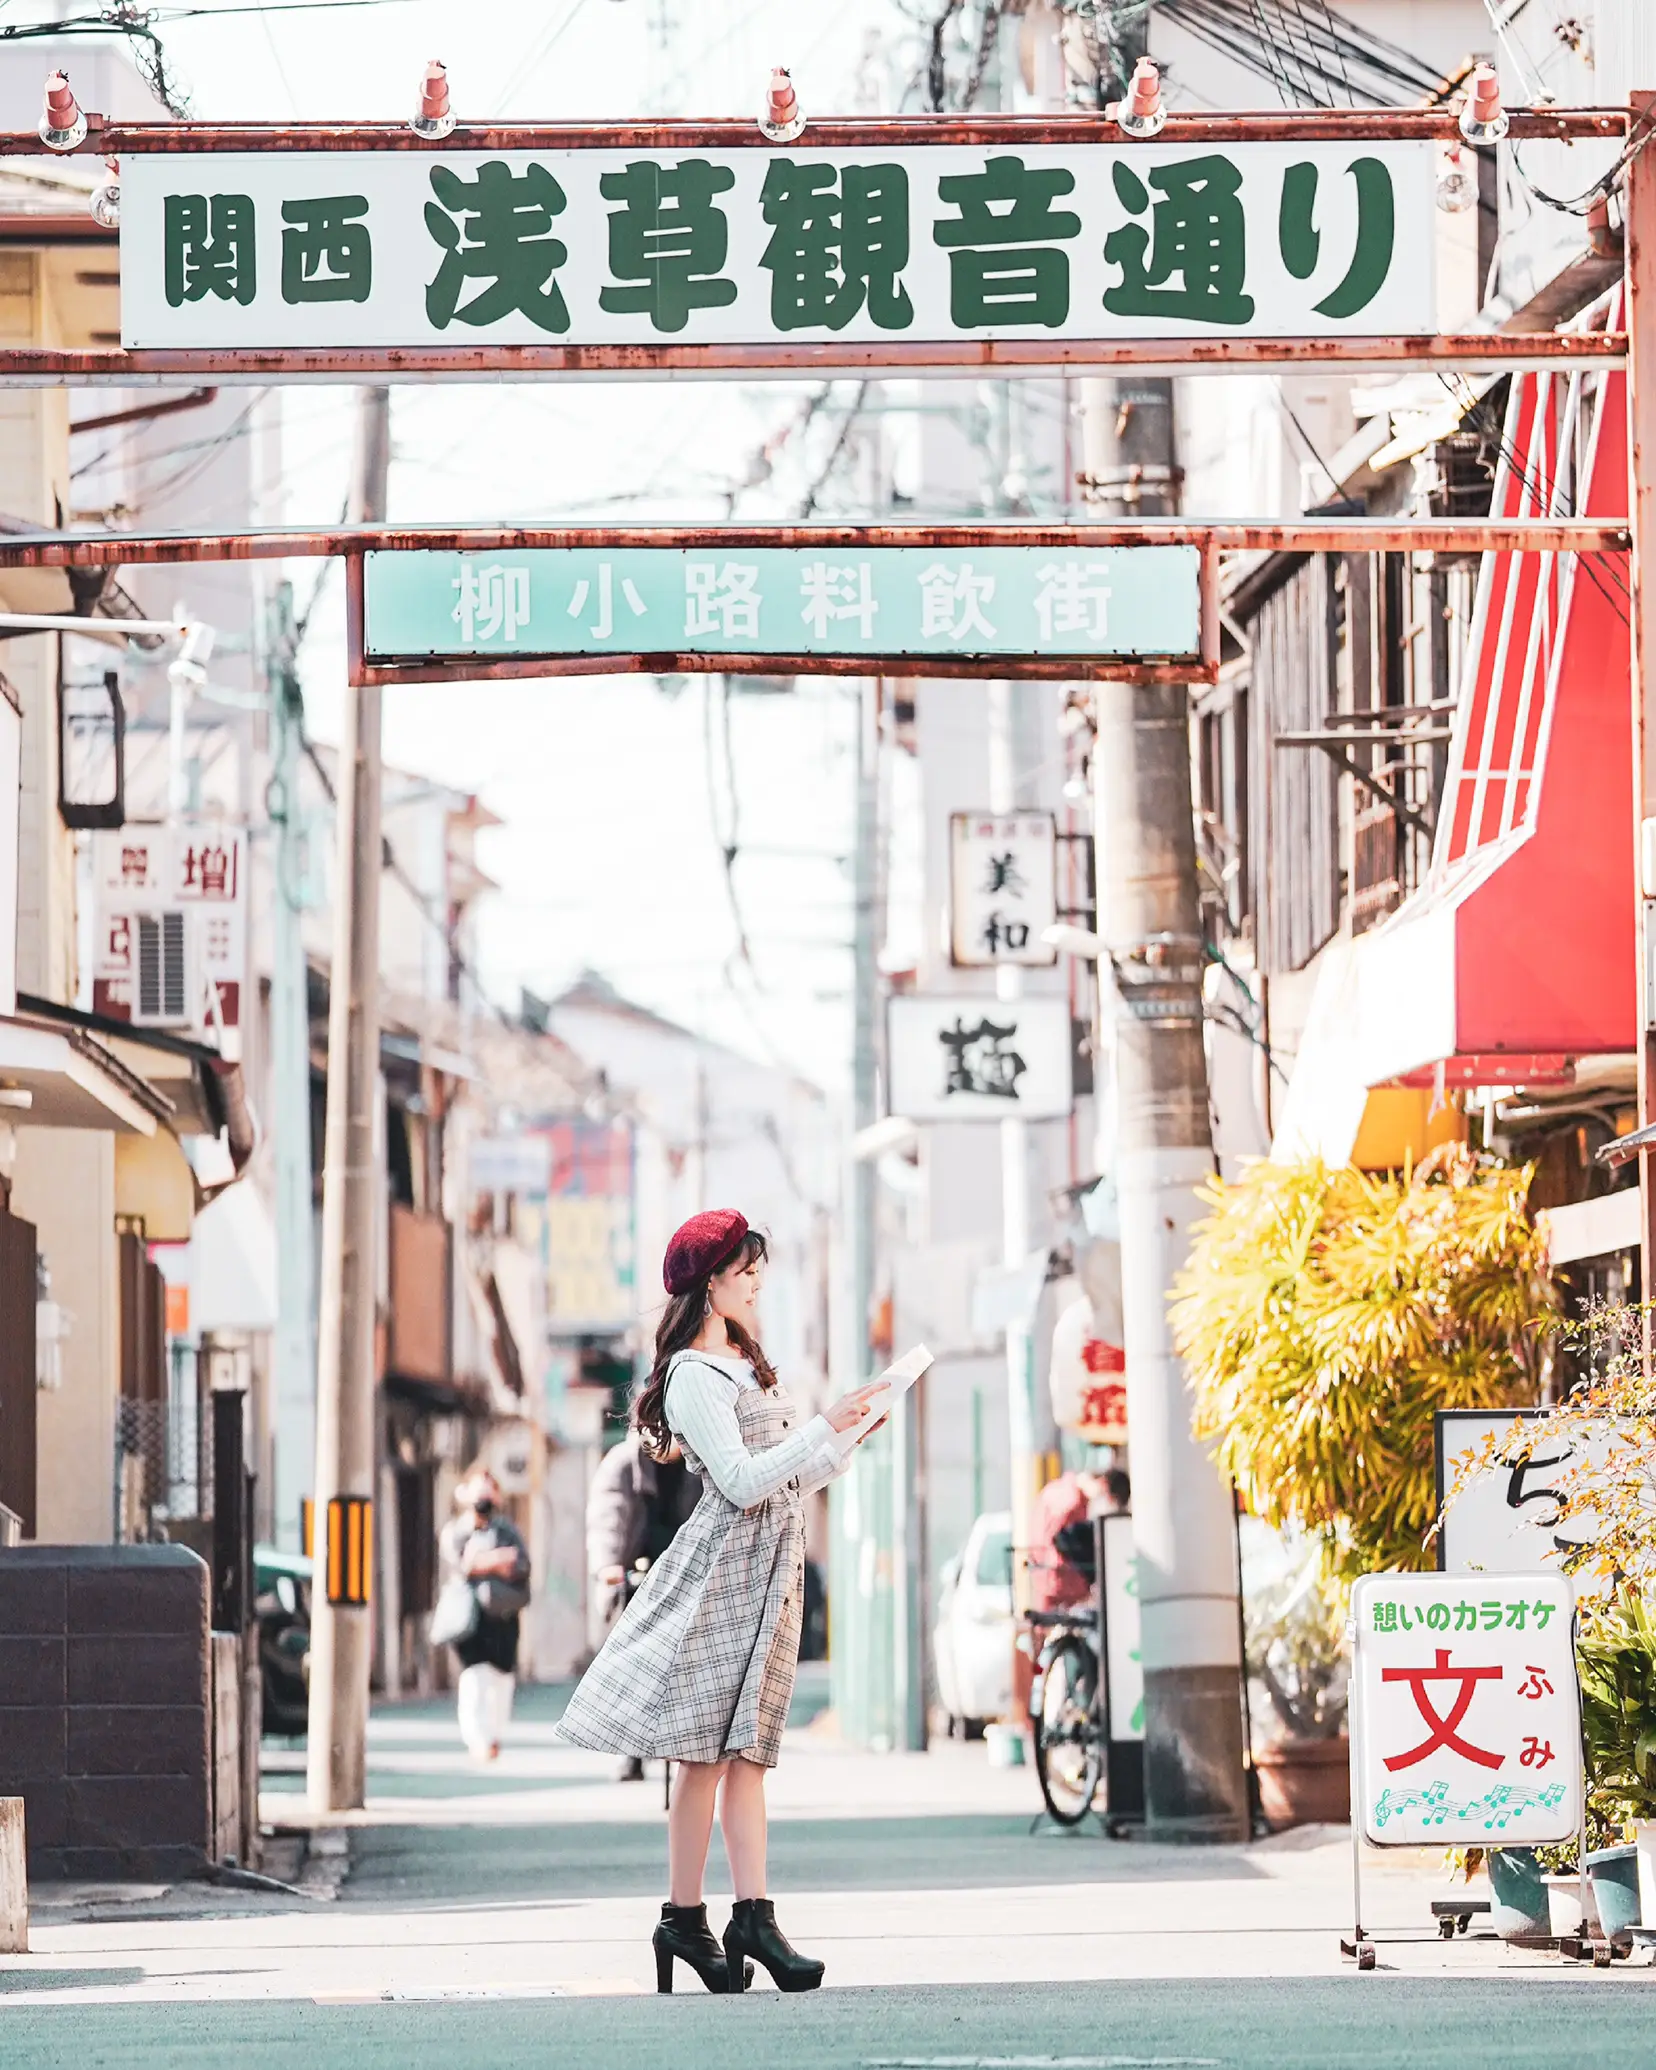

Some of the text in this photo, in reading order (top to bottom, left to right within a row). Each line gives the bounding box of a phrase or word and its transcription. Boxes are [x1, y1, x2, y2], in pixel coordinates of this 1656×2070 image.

[164, 155, 1396, 333] 関西 浅草観音通り
[451, 562, 1112, 642] 柳小路料飲街
[979, 851, 1030, 955] 美和
[1373, 1600, 1556, 1632] 憩いのカラオケ
[1381, 1648, 1506, 1773] 文
[1517, 1665, 1555, 1770] ふみ
